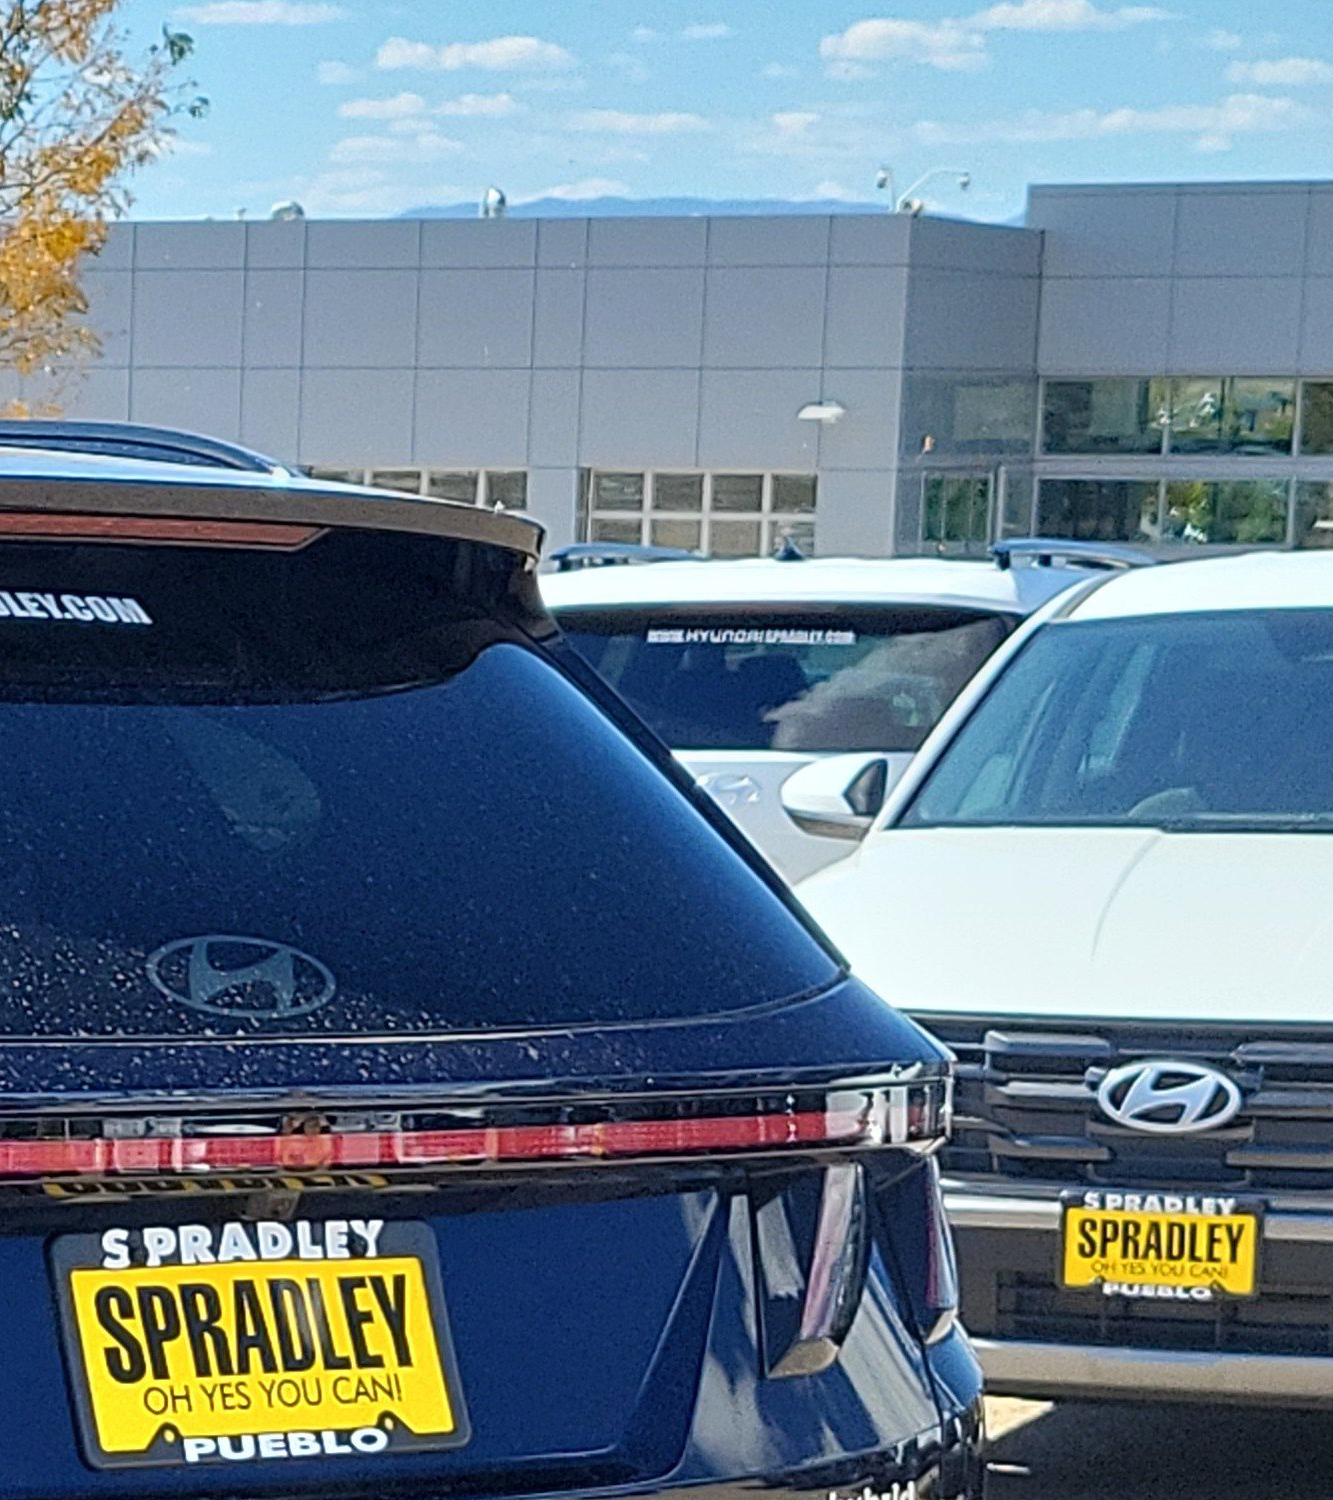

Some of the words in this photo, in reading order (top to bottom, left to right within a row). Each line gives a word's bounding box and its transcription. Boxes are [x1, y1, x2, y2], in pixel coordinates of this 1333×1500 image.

[1078, 1218, 1245, 1263] SPRADLEY
[1121, 1262, 1146, 1275] YES
[1151, 1262, 1184, 1277] YOU
[1102, 1282, 1214, 1299] PUEBLO
[94, 1273, 414, 1385] SPRADLEY
[143, 1386, 193, 1416] OH
[200, 1381, 252, 1412] YES
[258, 1377, 323, 1408] YOU
[332, 1373, 403, 1404] CAN!
[183, 1426, 389, 1463] PUEBLO
